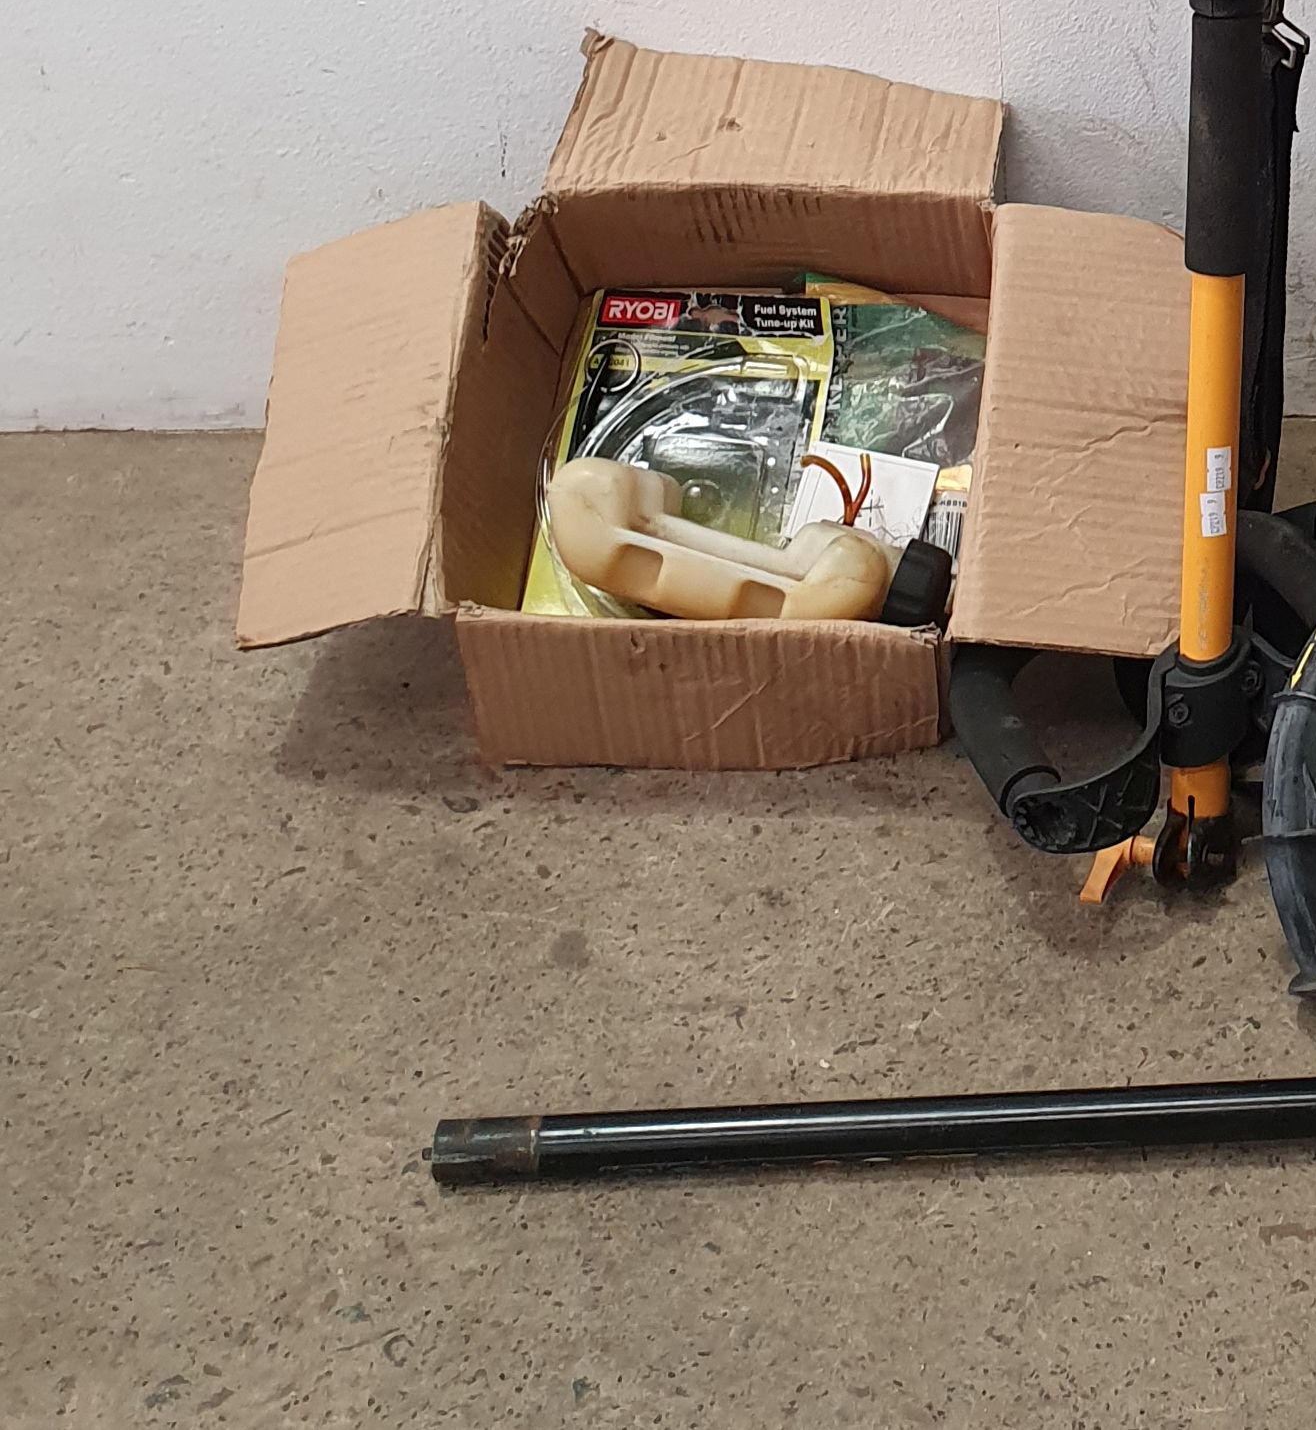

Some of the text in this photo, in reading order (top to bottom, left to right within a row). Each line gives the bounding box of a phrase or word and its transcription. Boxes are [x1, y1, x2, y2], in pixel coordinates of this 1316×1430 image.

[608, 300, 676, 320] RYOBI
[754, 303, 817, 318] Fuel System
[755, 318, 815, 330] Tune-up Kit
